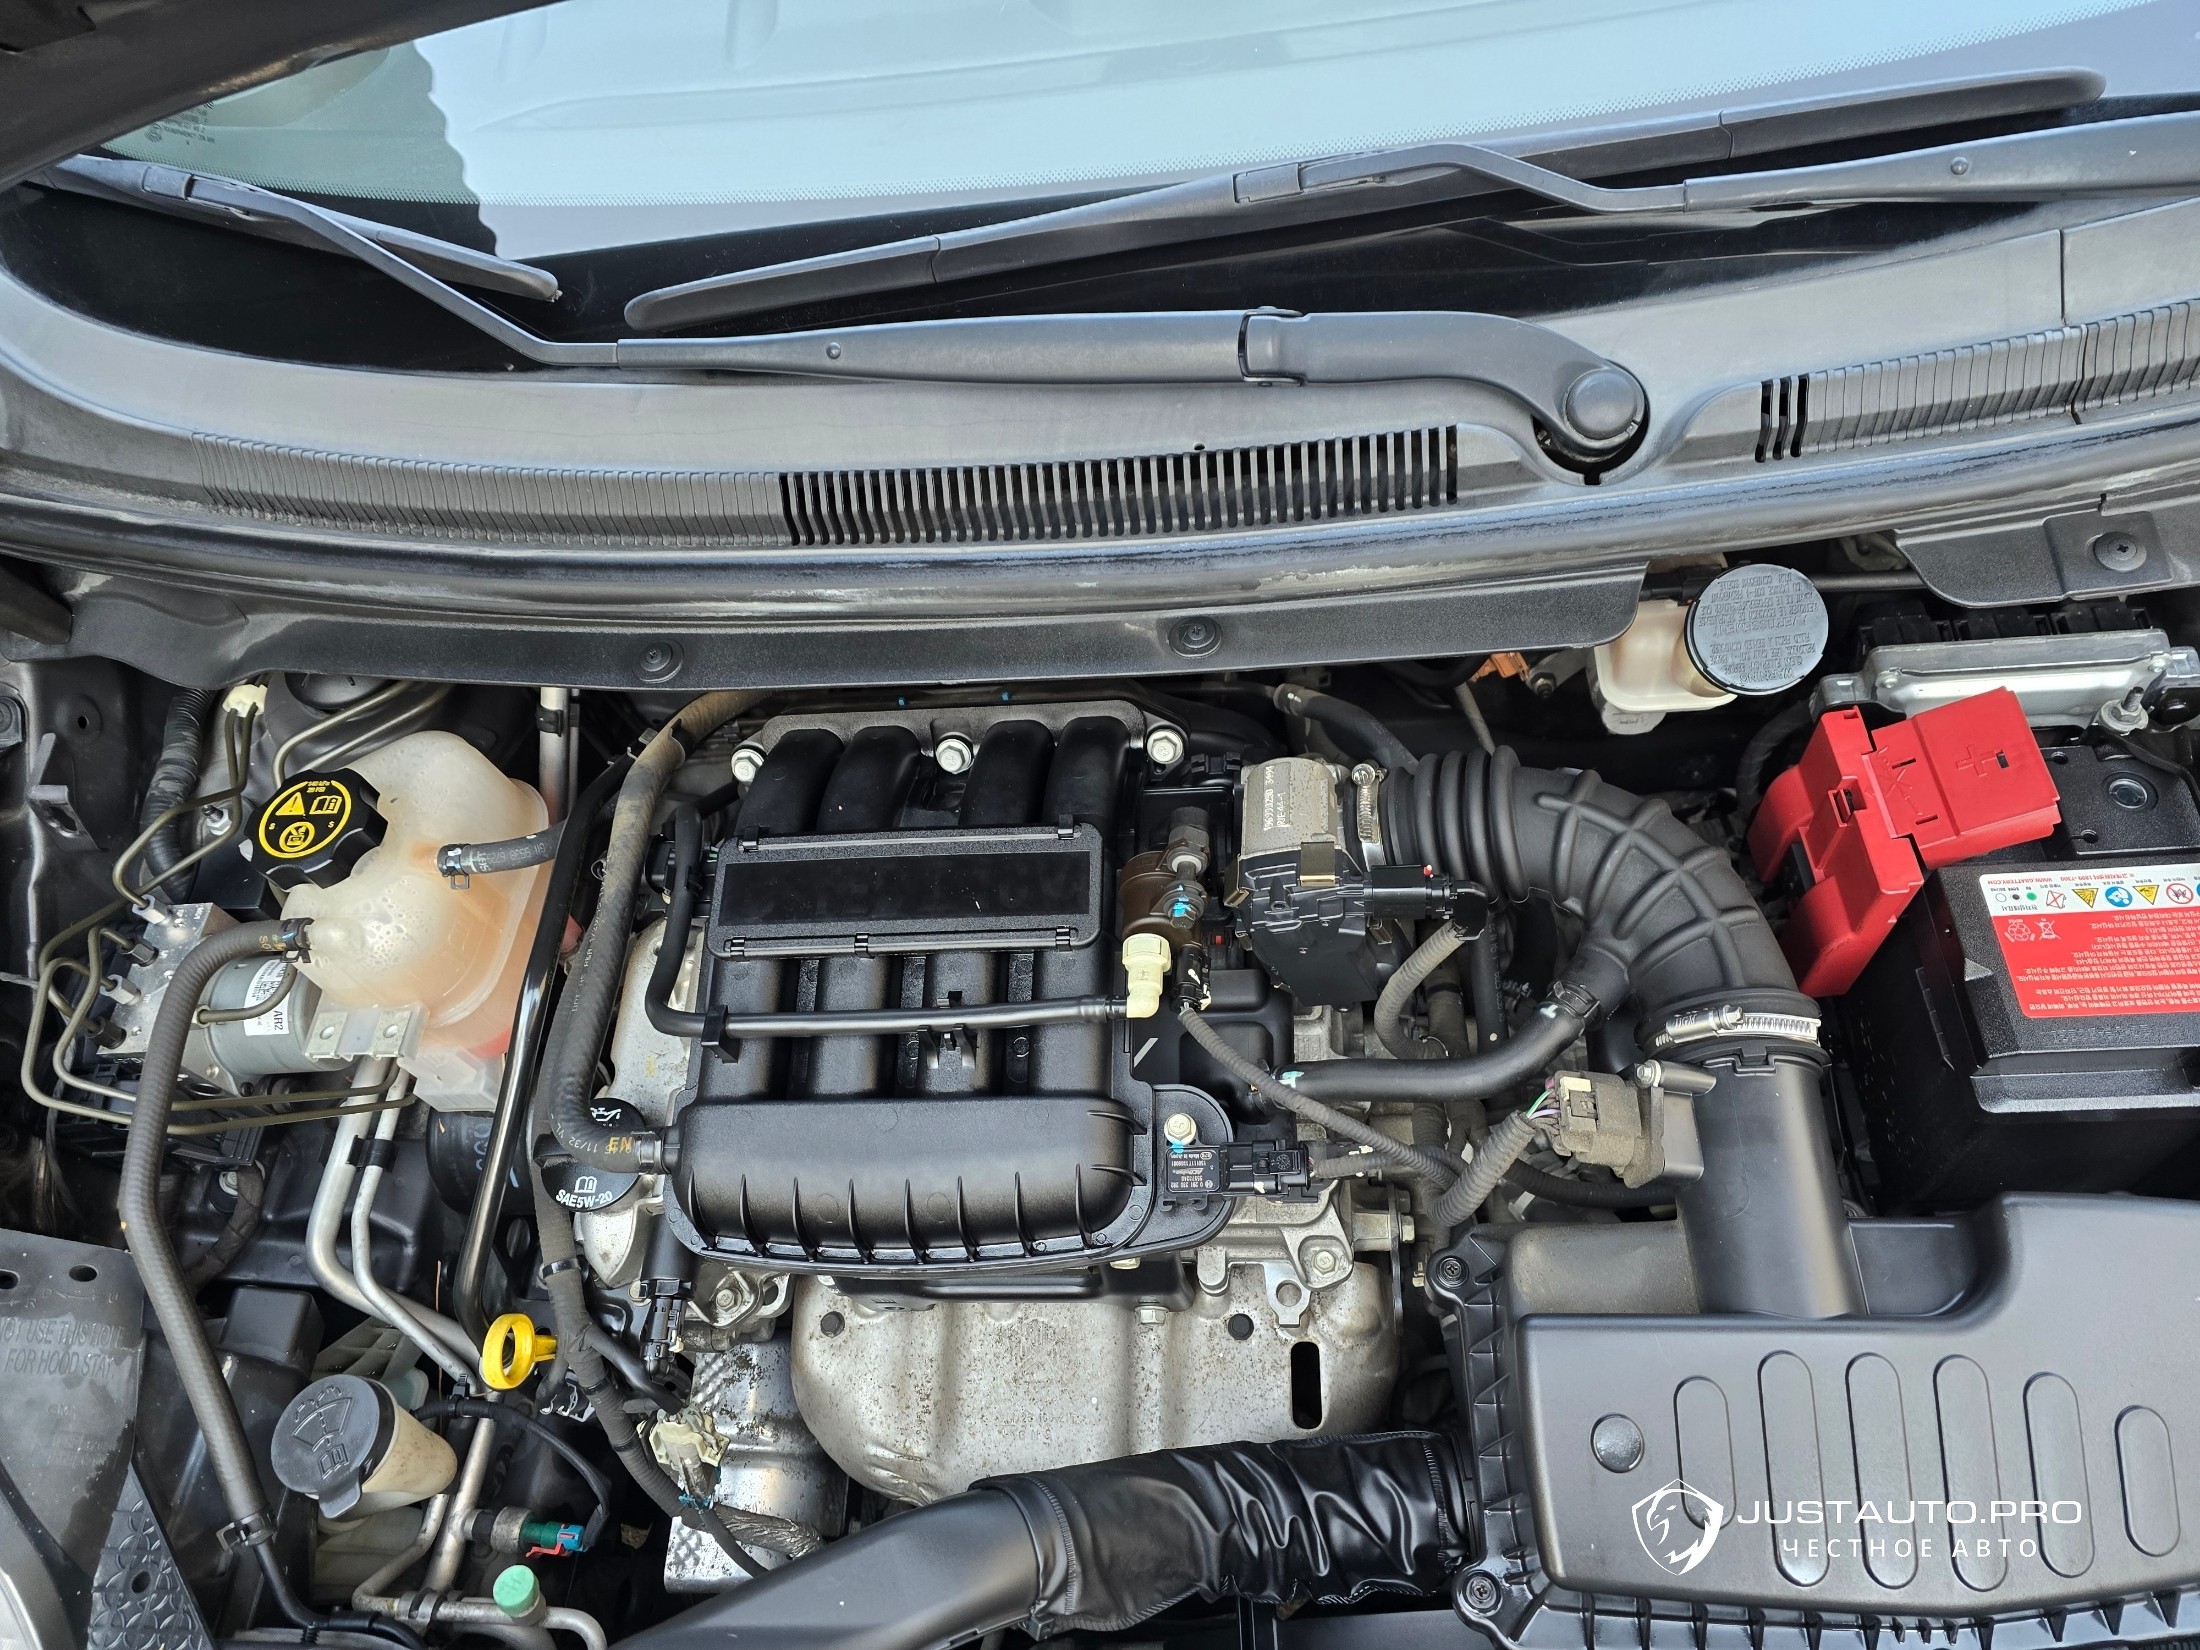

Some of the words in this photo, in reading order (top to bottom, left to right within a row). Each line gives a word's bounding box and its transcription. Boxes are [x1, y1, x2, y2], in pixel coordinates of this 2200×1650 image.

[273, 1010, 284, 1030] AR2
[555, 1189, 612, 1208] SAE5W-20
[26, 1318, 56, 1345] USE
[57, 1321, 88, 1347] THIS
[4, 1347, 36, 1374] FOR
[37, 1349, 79, 1376] HOOD
